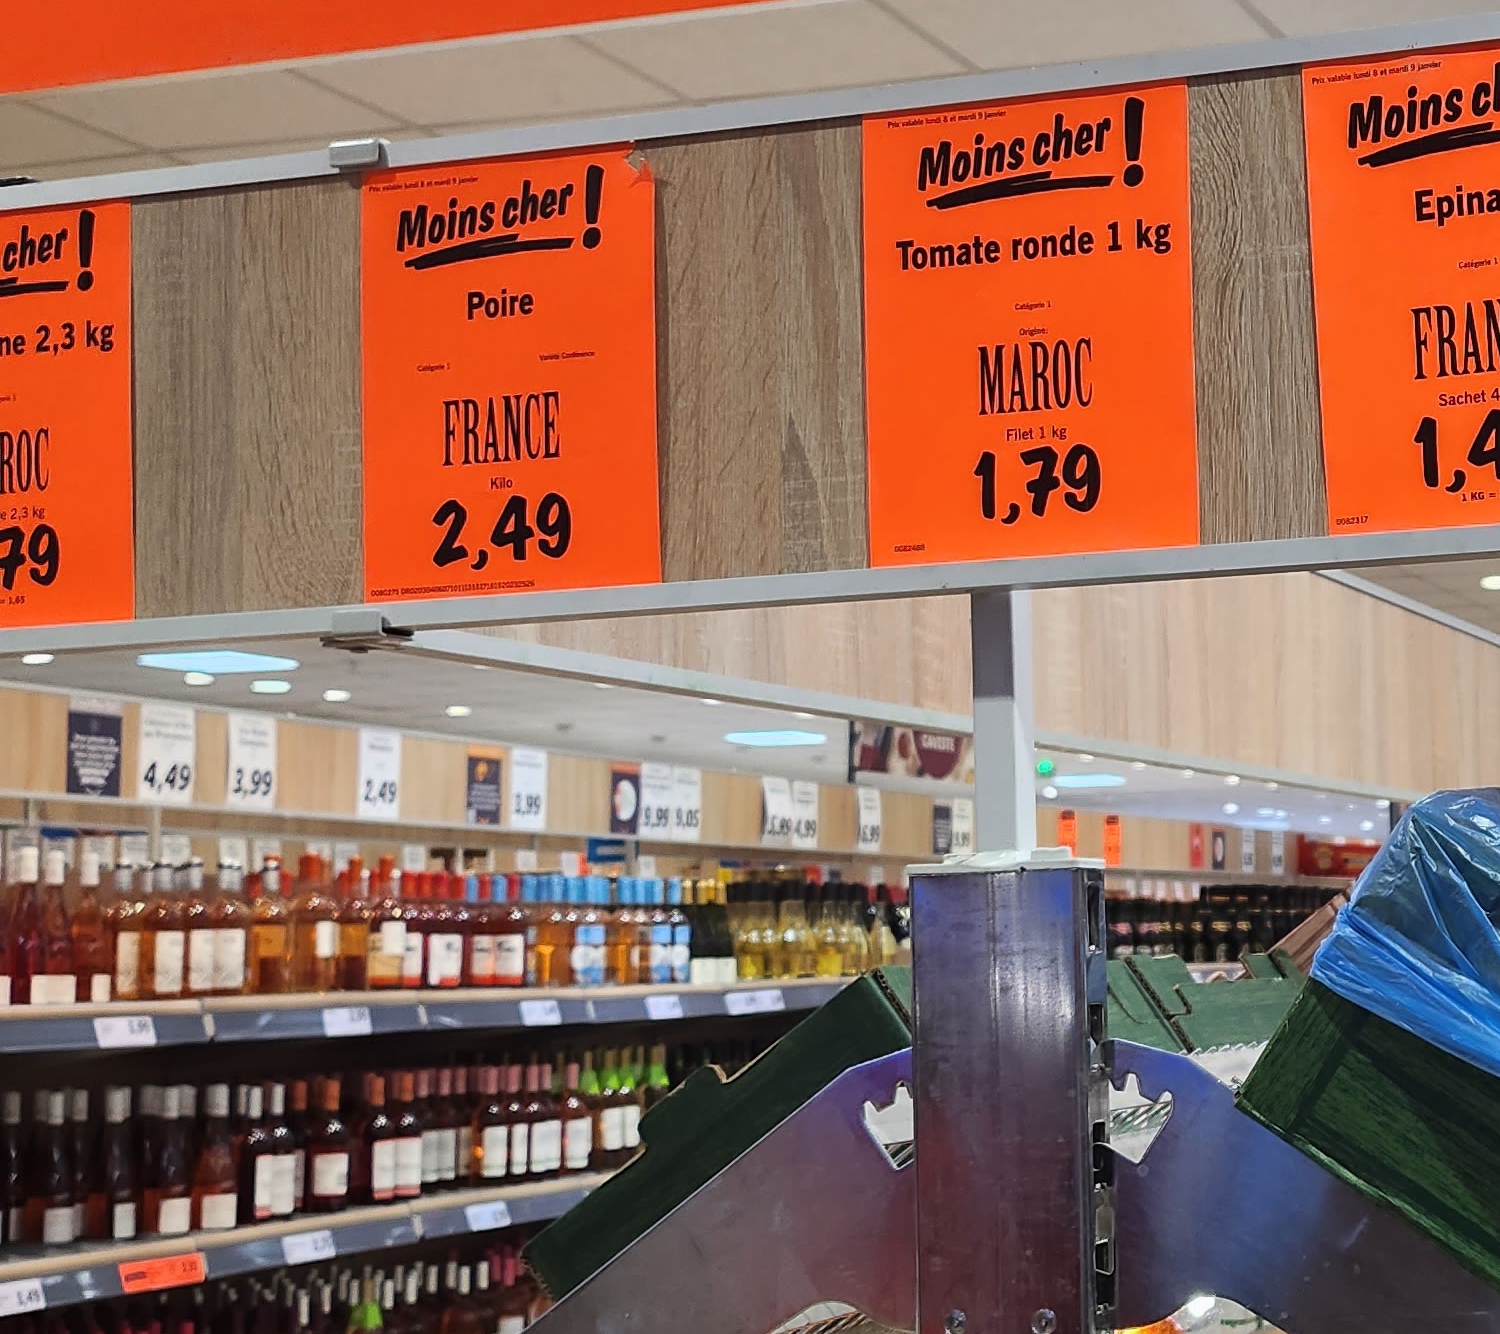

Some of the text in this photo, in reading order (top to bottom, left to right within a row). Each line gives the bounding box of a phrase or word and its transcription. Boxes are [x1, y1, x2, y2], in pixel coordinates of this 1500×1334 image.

[1347, 86, 1463, 149] Moins
[918, 133, 1025, 191] Moins
[1032, 113, 1111, 165] cher
[396, 198, 495, 251] Moins
[502, 180, 574, 228] cher
[3, 224, 68, 272] cher
[896, 218, 1172, 271] Tomate ronde 1 kg
[467, 288, 534, 320] Poire
[35, 322, 76, 356] 2,3
[84, 319, 115, 352] kg
[977, 337, 1093, 416] MAROC
[1438, 389, 1487, 407] Sachet
[442, 391, 560, 466] FRANCE
[1006, 425, 1067, 442] Filet 1 kg
[490, 477, 513, 489] Kilo
[973, 443, 1101, 525] 1,79
[1470, 491, 1485, 501] KG
[9, 507, 29, 521] 2,3
[32, 506, 45, 520] kg
[432, 492, 572, 571] 2,49
[144, 761, 191, 794] 4,49
[233, 768, 273, 800] 3,99
[364, 779, 397, 806] 2,49
